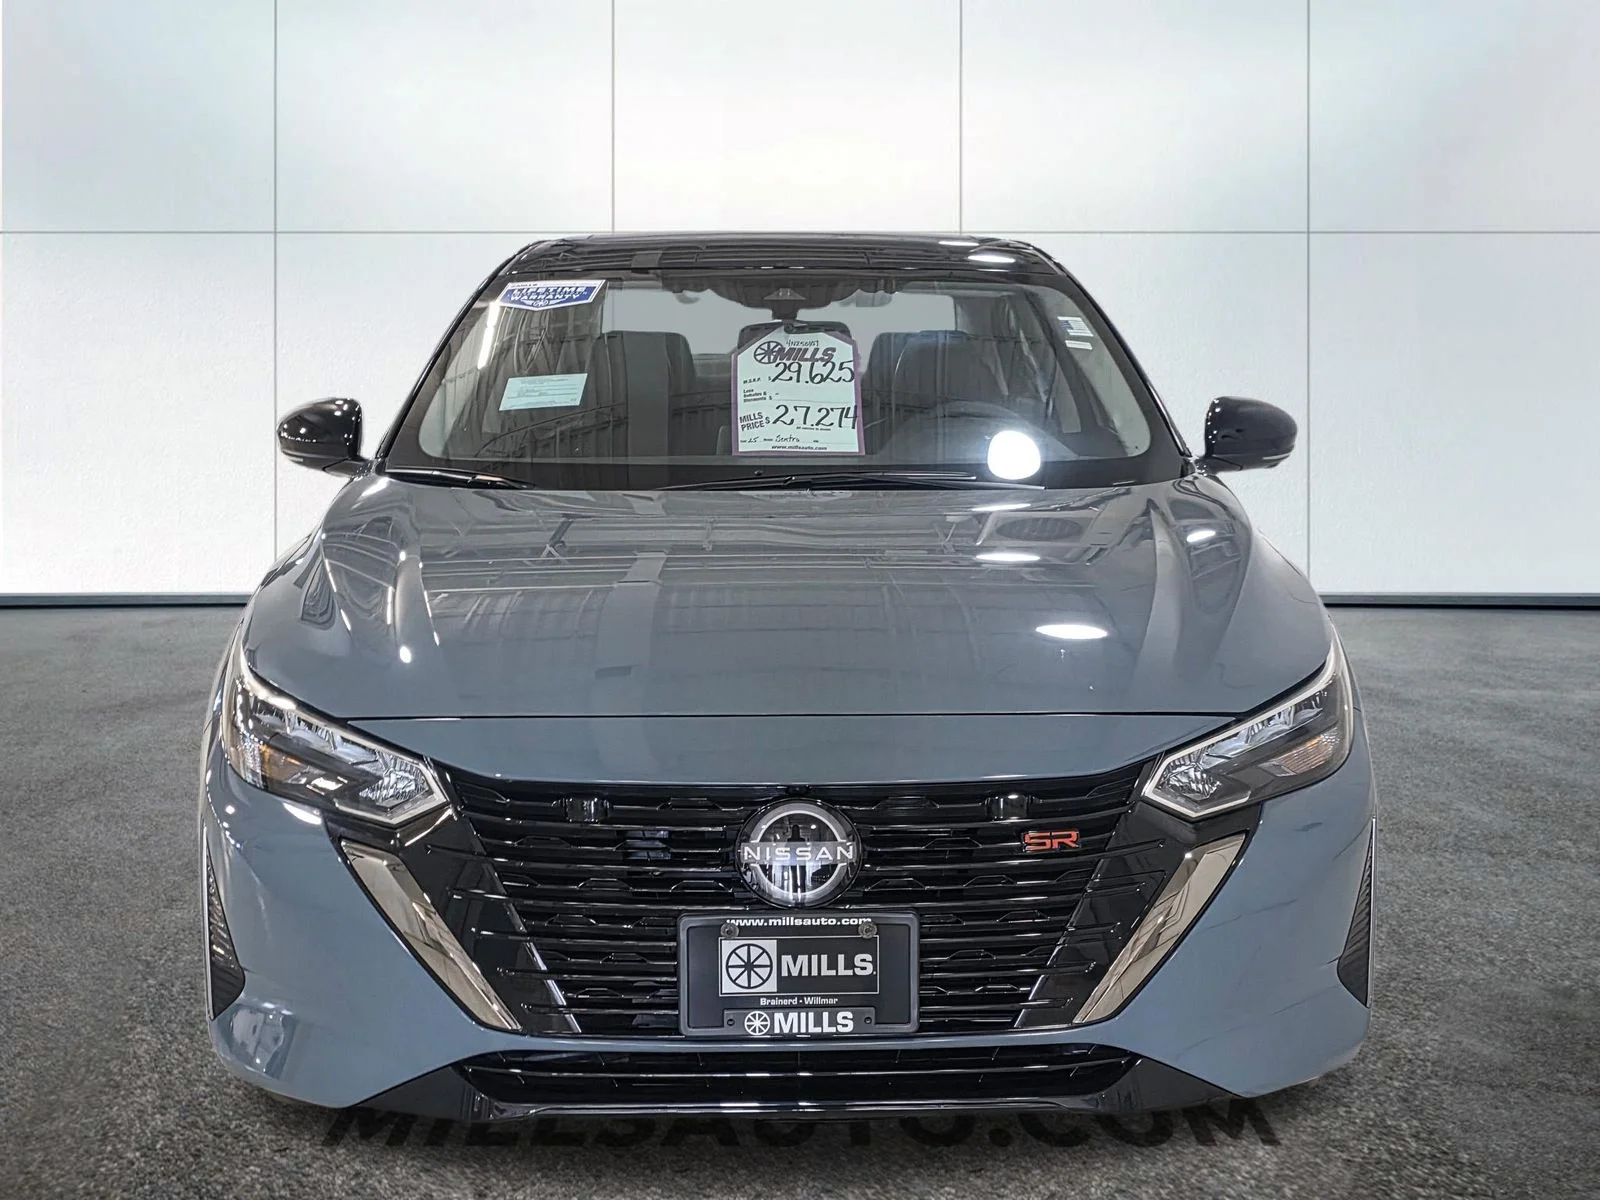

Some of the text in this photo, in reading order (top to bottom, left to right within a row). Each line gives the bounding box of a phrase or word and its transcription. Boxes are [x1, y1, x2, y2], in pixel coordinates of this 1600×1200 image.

[510, 293, 580, 301] WARRANTY
[512, 286, 586, 295] LIFETIME
[773, 347, 836, 362] MILLS
[771, 360, 855, 385] 29.625
[740, 412, 763, 424] MILLS
[741, 420, 765, 432] PRICE
[765, 416, 770, 424] $
[772, 404, 857, 430] 27.274
[1023, 830, 1079, 852] SR
[743, 846, 853, 861] NISSAN
[781, 954, 874, 977] MILLS
[803, 996, 839, 1005] Willmar
[774, 1011, 854, 1034] MILLS
